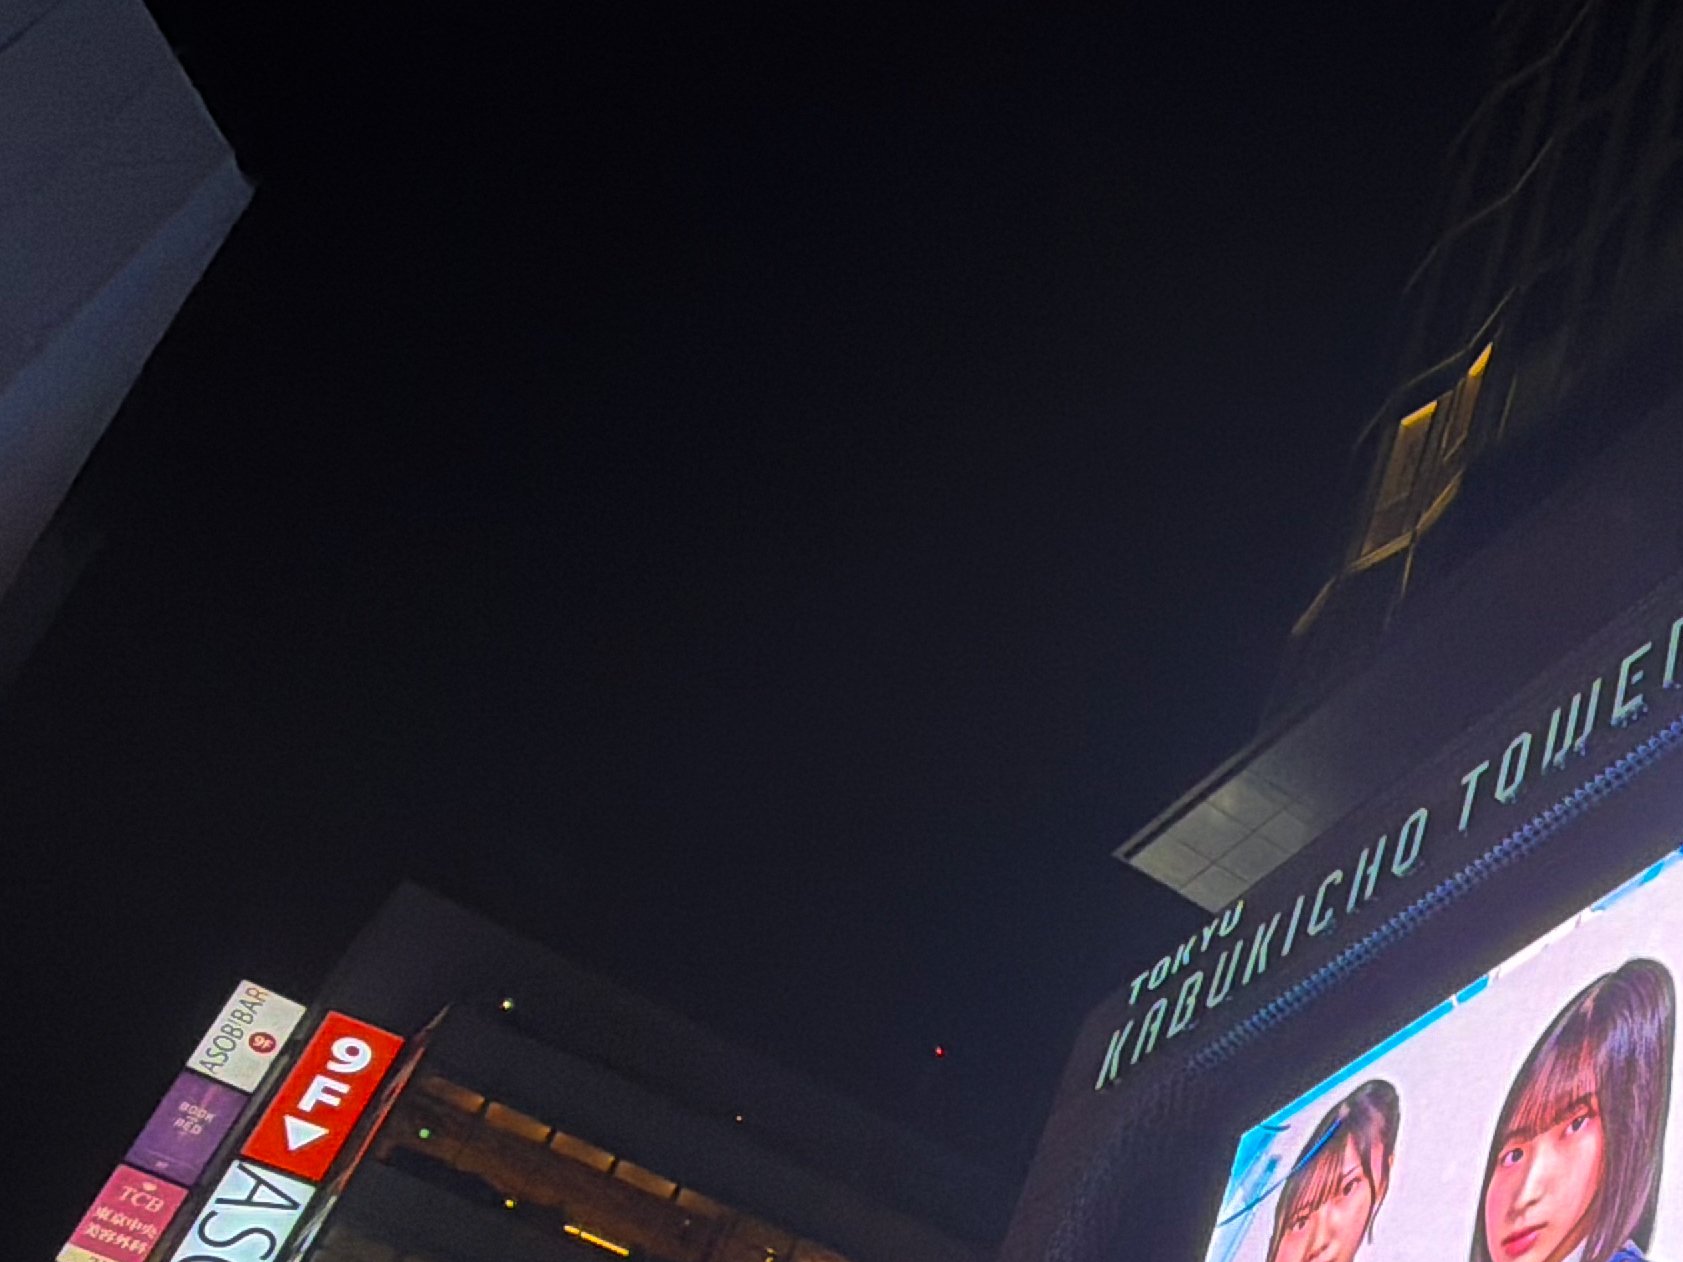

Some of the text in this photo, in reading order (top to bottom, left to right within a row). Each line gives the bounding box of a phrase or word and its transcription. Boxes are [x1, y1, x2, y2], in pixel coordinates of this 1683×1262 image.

[1095, 807, 1429, 1091] KABUKICHO
[199, 986, 270, 1075] ASOBIBAR
[297, 1036, 372, 1113] 9F
[120, 1186, 164, 1213] TCB
